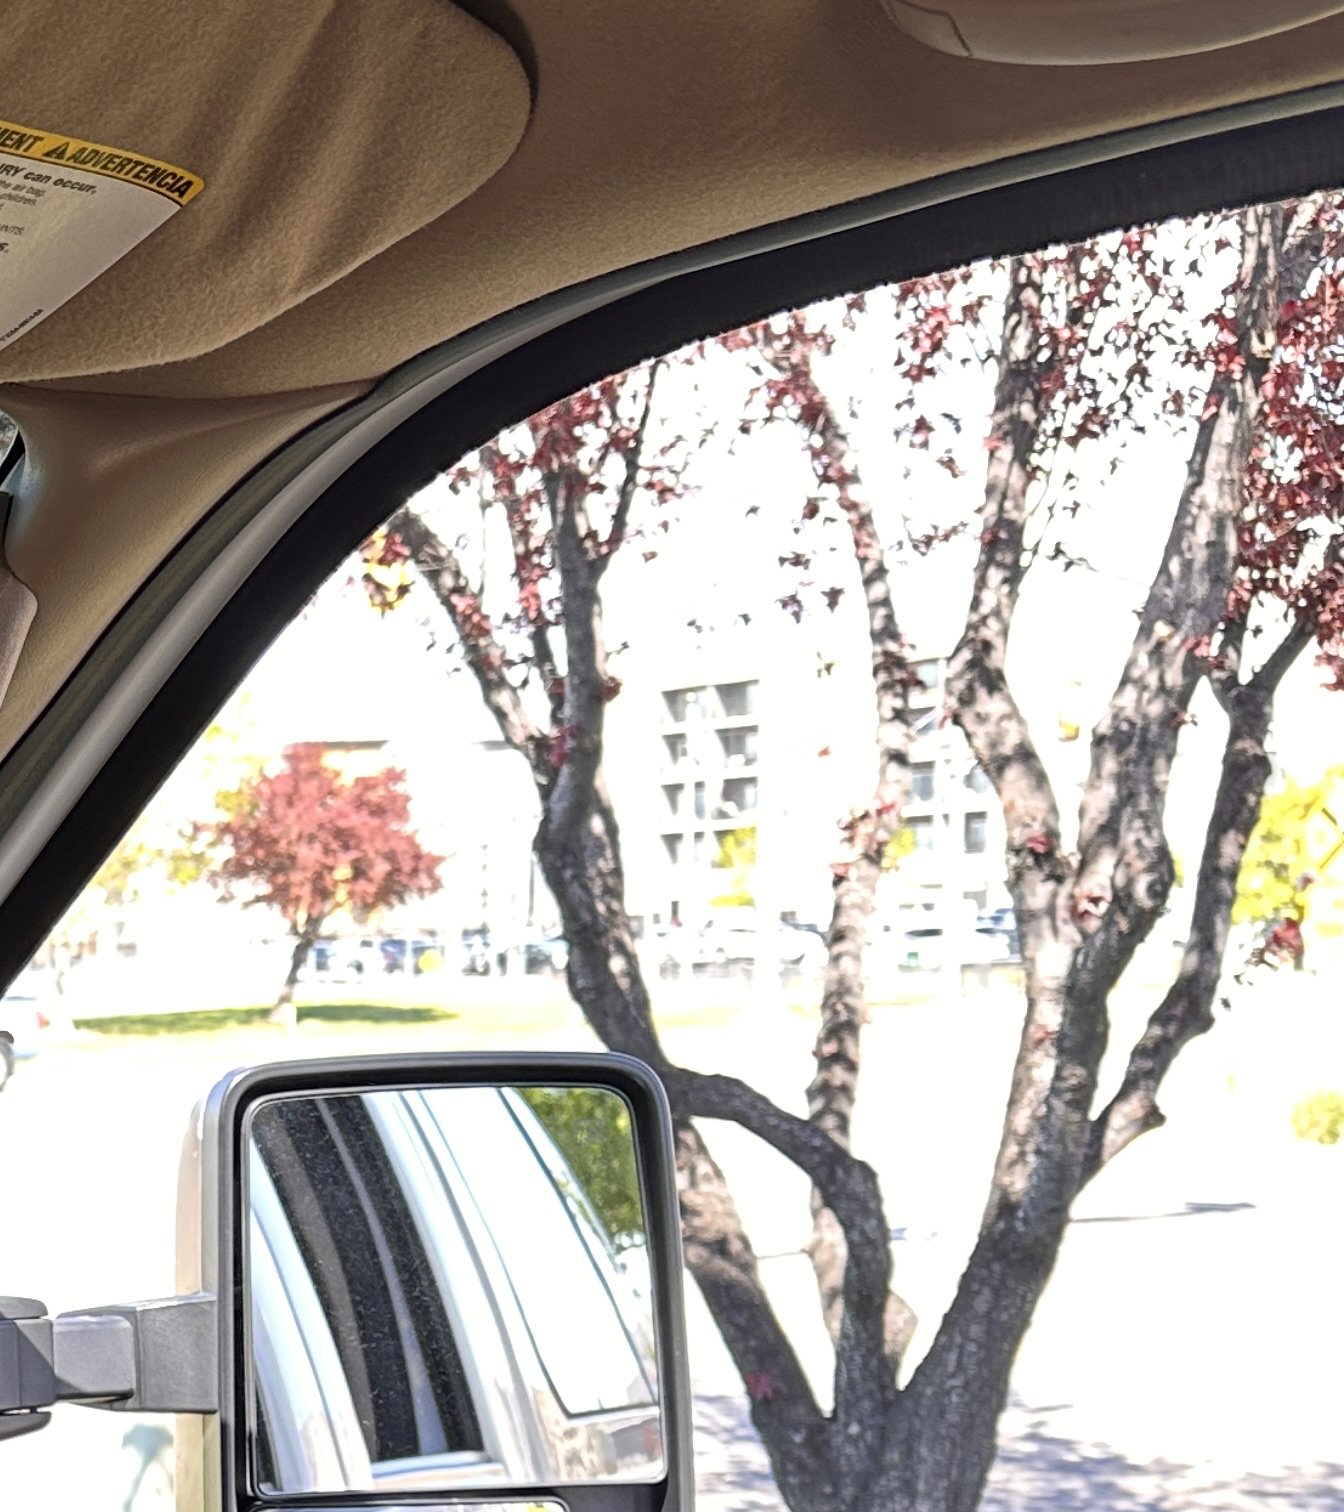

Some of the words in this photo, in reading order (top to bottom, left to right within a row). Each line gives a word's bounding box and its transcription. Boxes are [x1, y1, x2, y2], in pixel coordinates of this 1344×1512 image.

[23, 172, 52, 184] can
[53, 178, 97, 194] occur.
[67, 145, 195, 198] ADVERTENCIA
